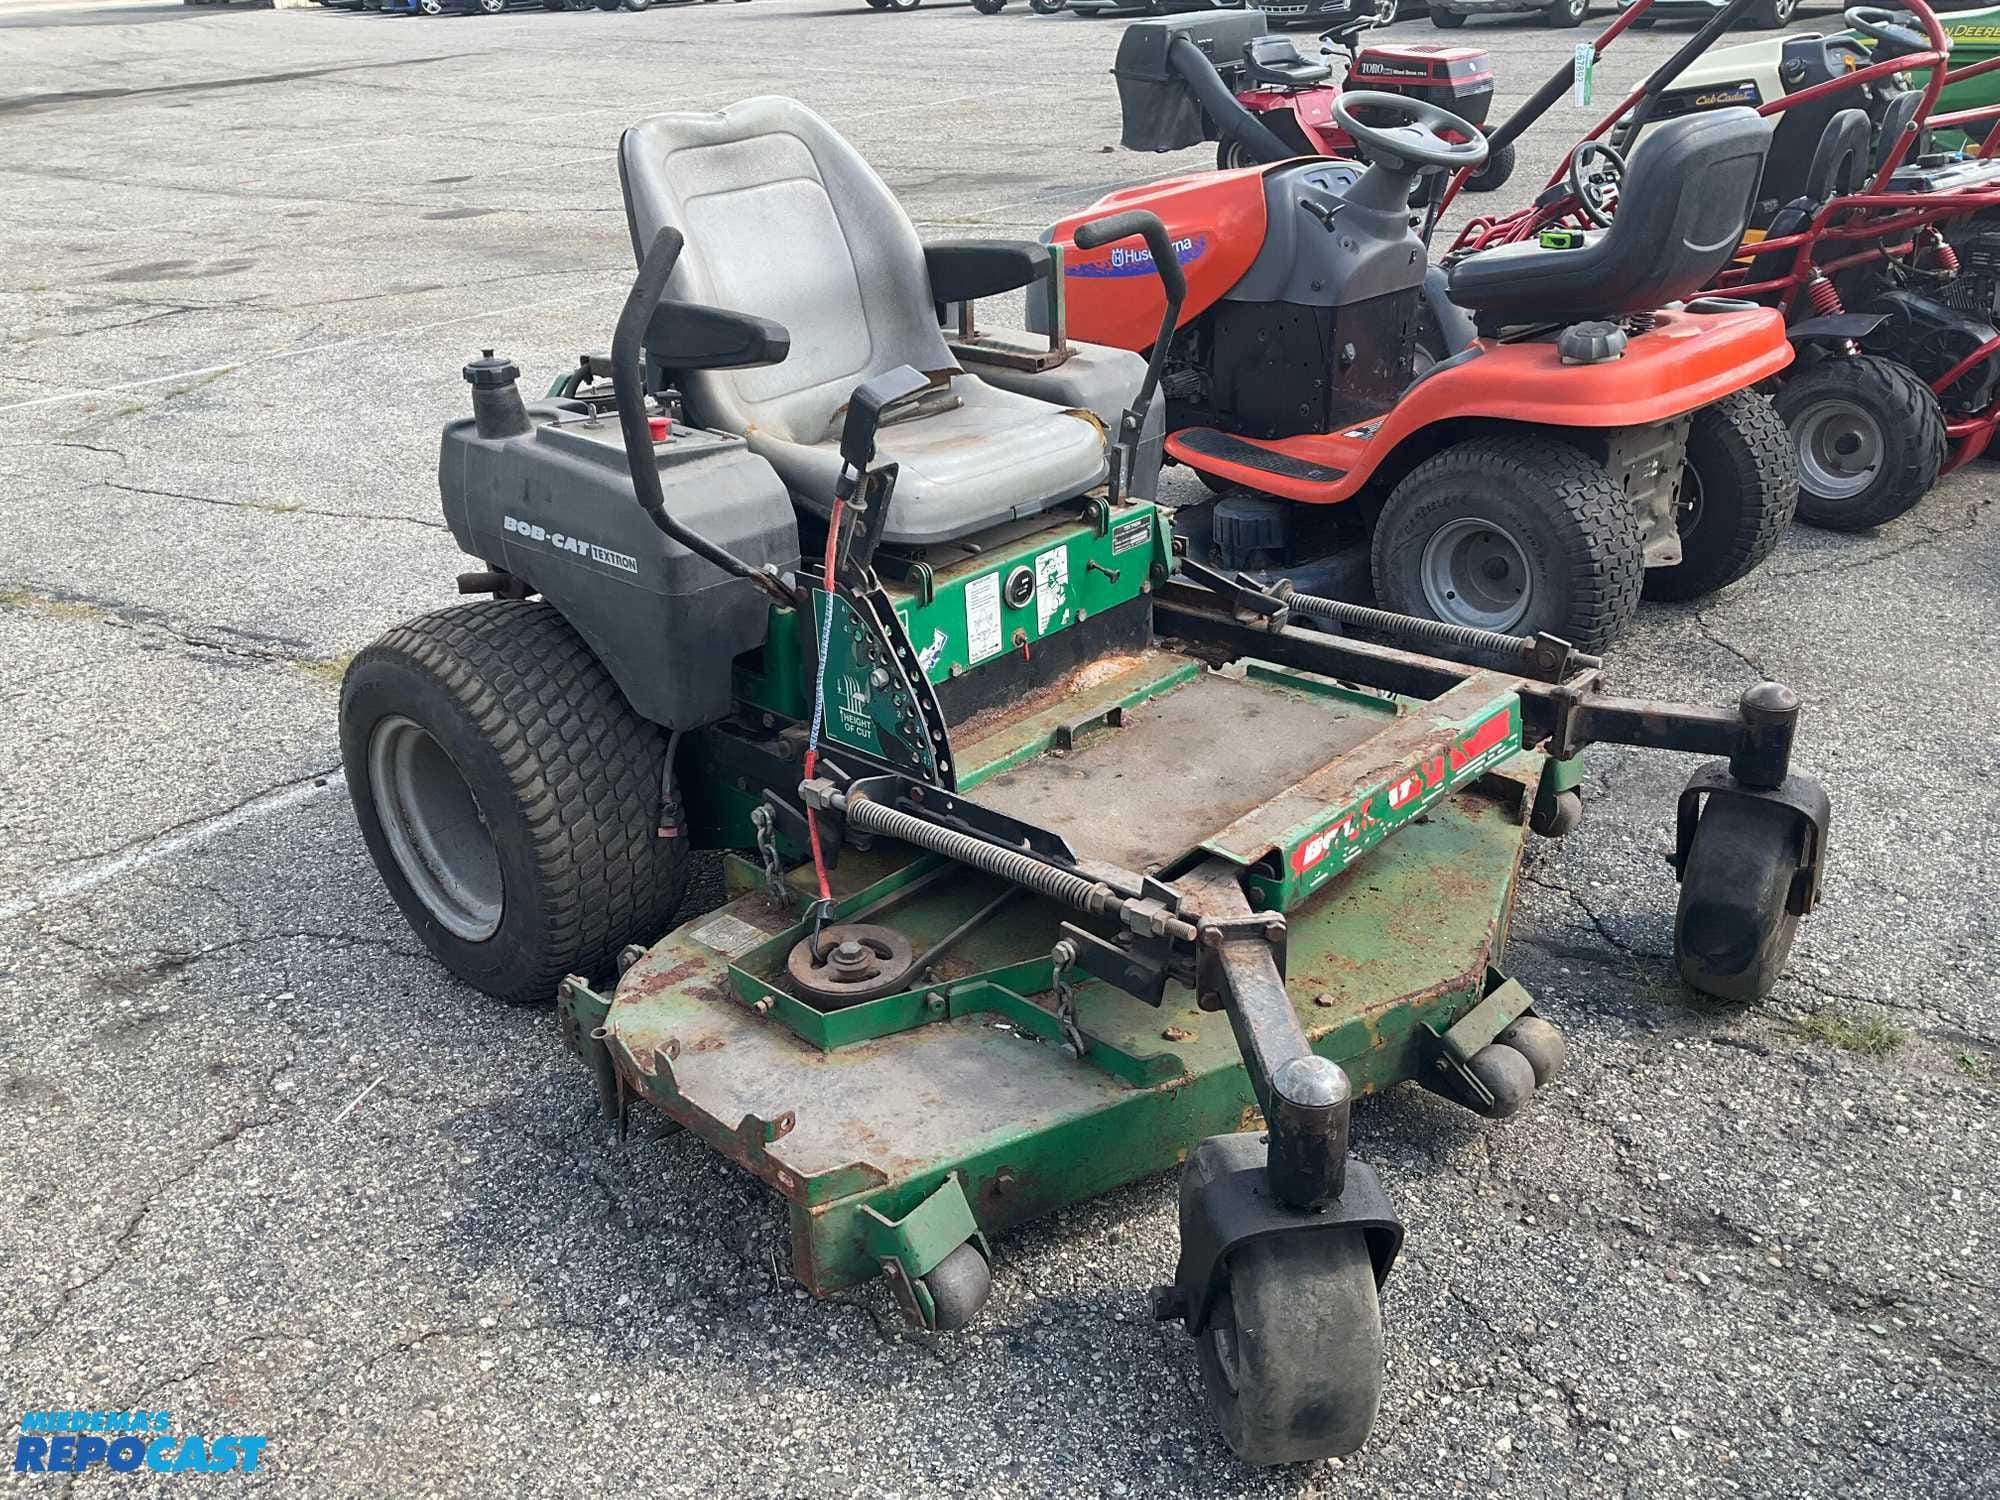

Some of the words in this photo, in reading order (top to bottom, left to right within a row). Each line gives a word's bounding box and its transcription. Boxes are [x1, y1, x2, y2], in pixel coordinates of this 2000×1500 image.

[1361, 63, 1384, 75] TORO
[1696, 94, 1716, 105] Cub
[1125, 238, 1193, 264] Husrna
[592, 547, 637, 571] TEXTRON
[843, 713, 871, 730] HEIGHT
[844, 722, 855, 733] OF
[856, 726, 871, 740] CUT
